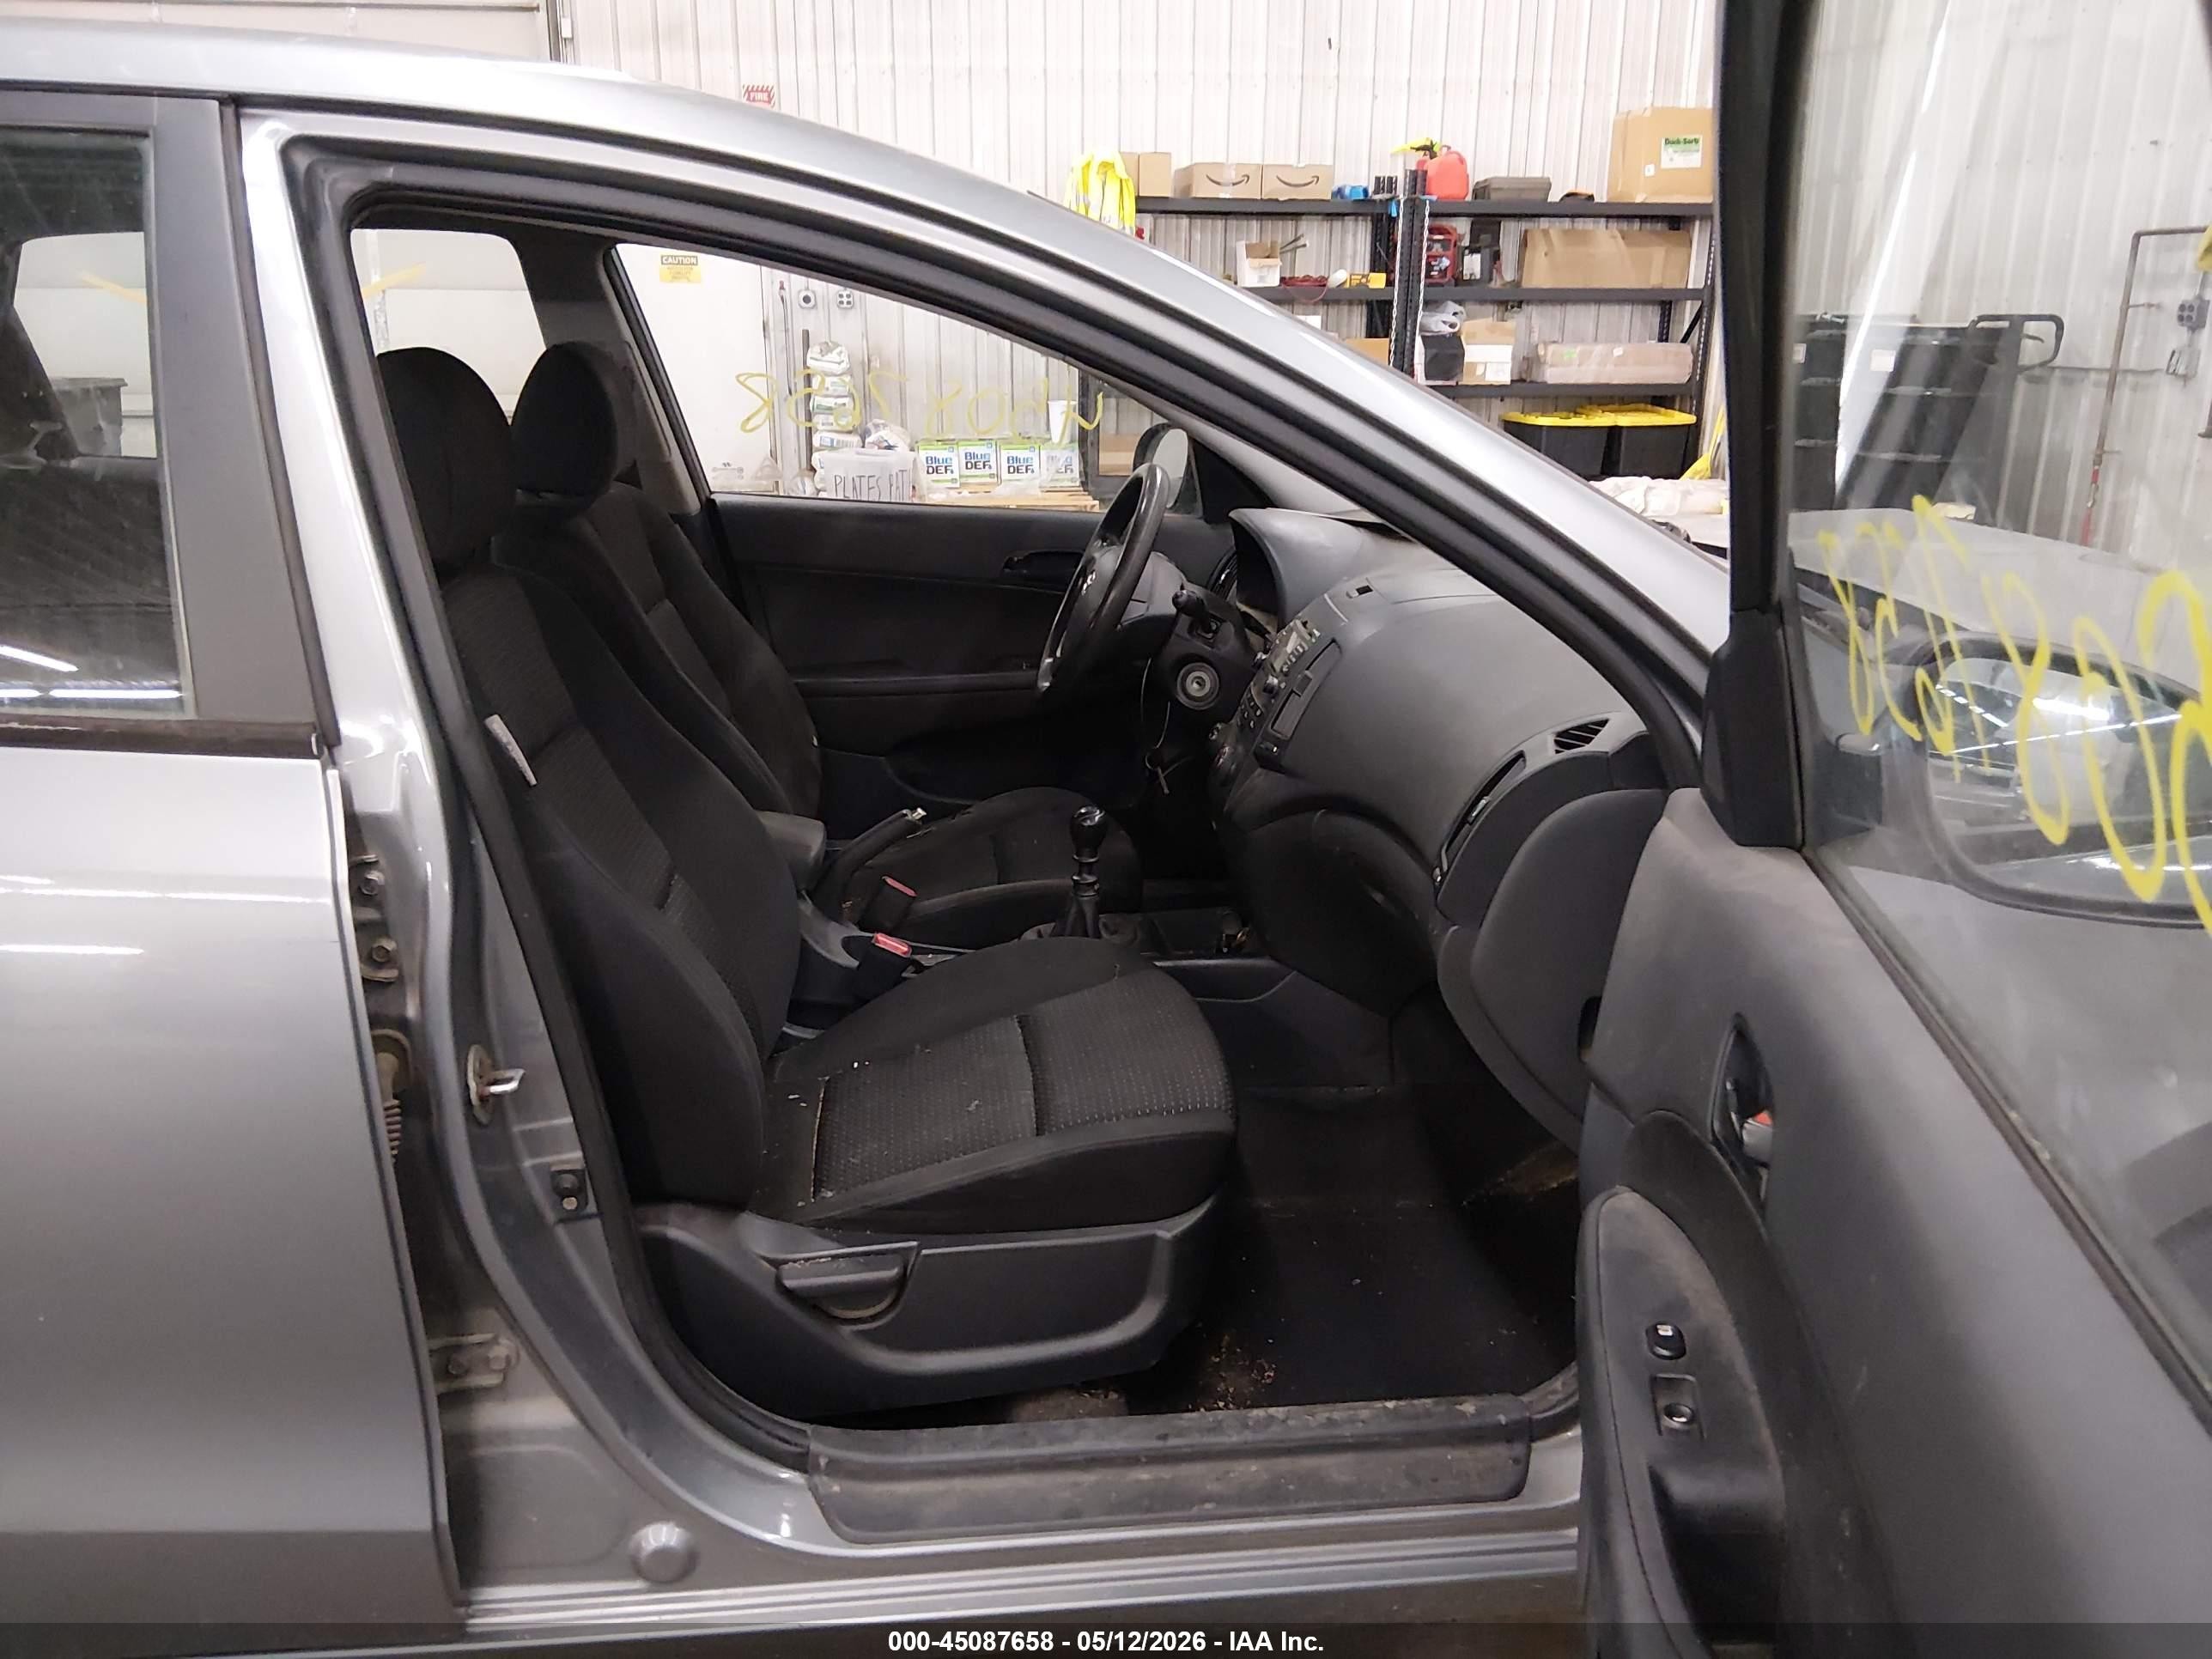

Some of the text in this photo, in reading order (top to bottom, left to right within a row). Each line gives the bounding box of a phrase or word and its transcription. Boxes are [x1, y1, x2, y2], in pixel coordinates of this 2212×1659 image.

[926, 456, 952, 465] Blue
[964, 452, 990, 460] Blue
[1006, 456, 1033, 465] Blue
[927, 465, 952, 474] DEF
[965, 461, 990, 470] DEF
[1007, 465, 1033, 474] DEF
[834, 474, 881, 501] PLATES
